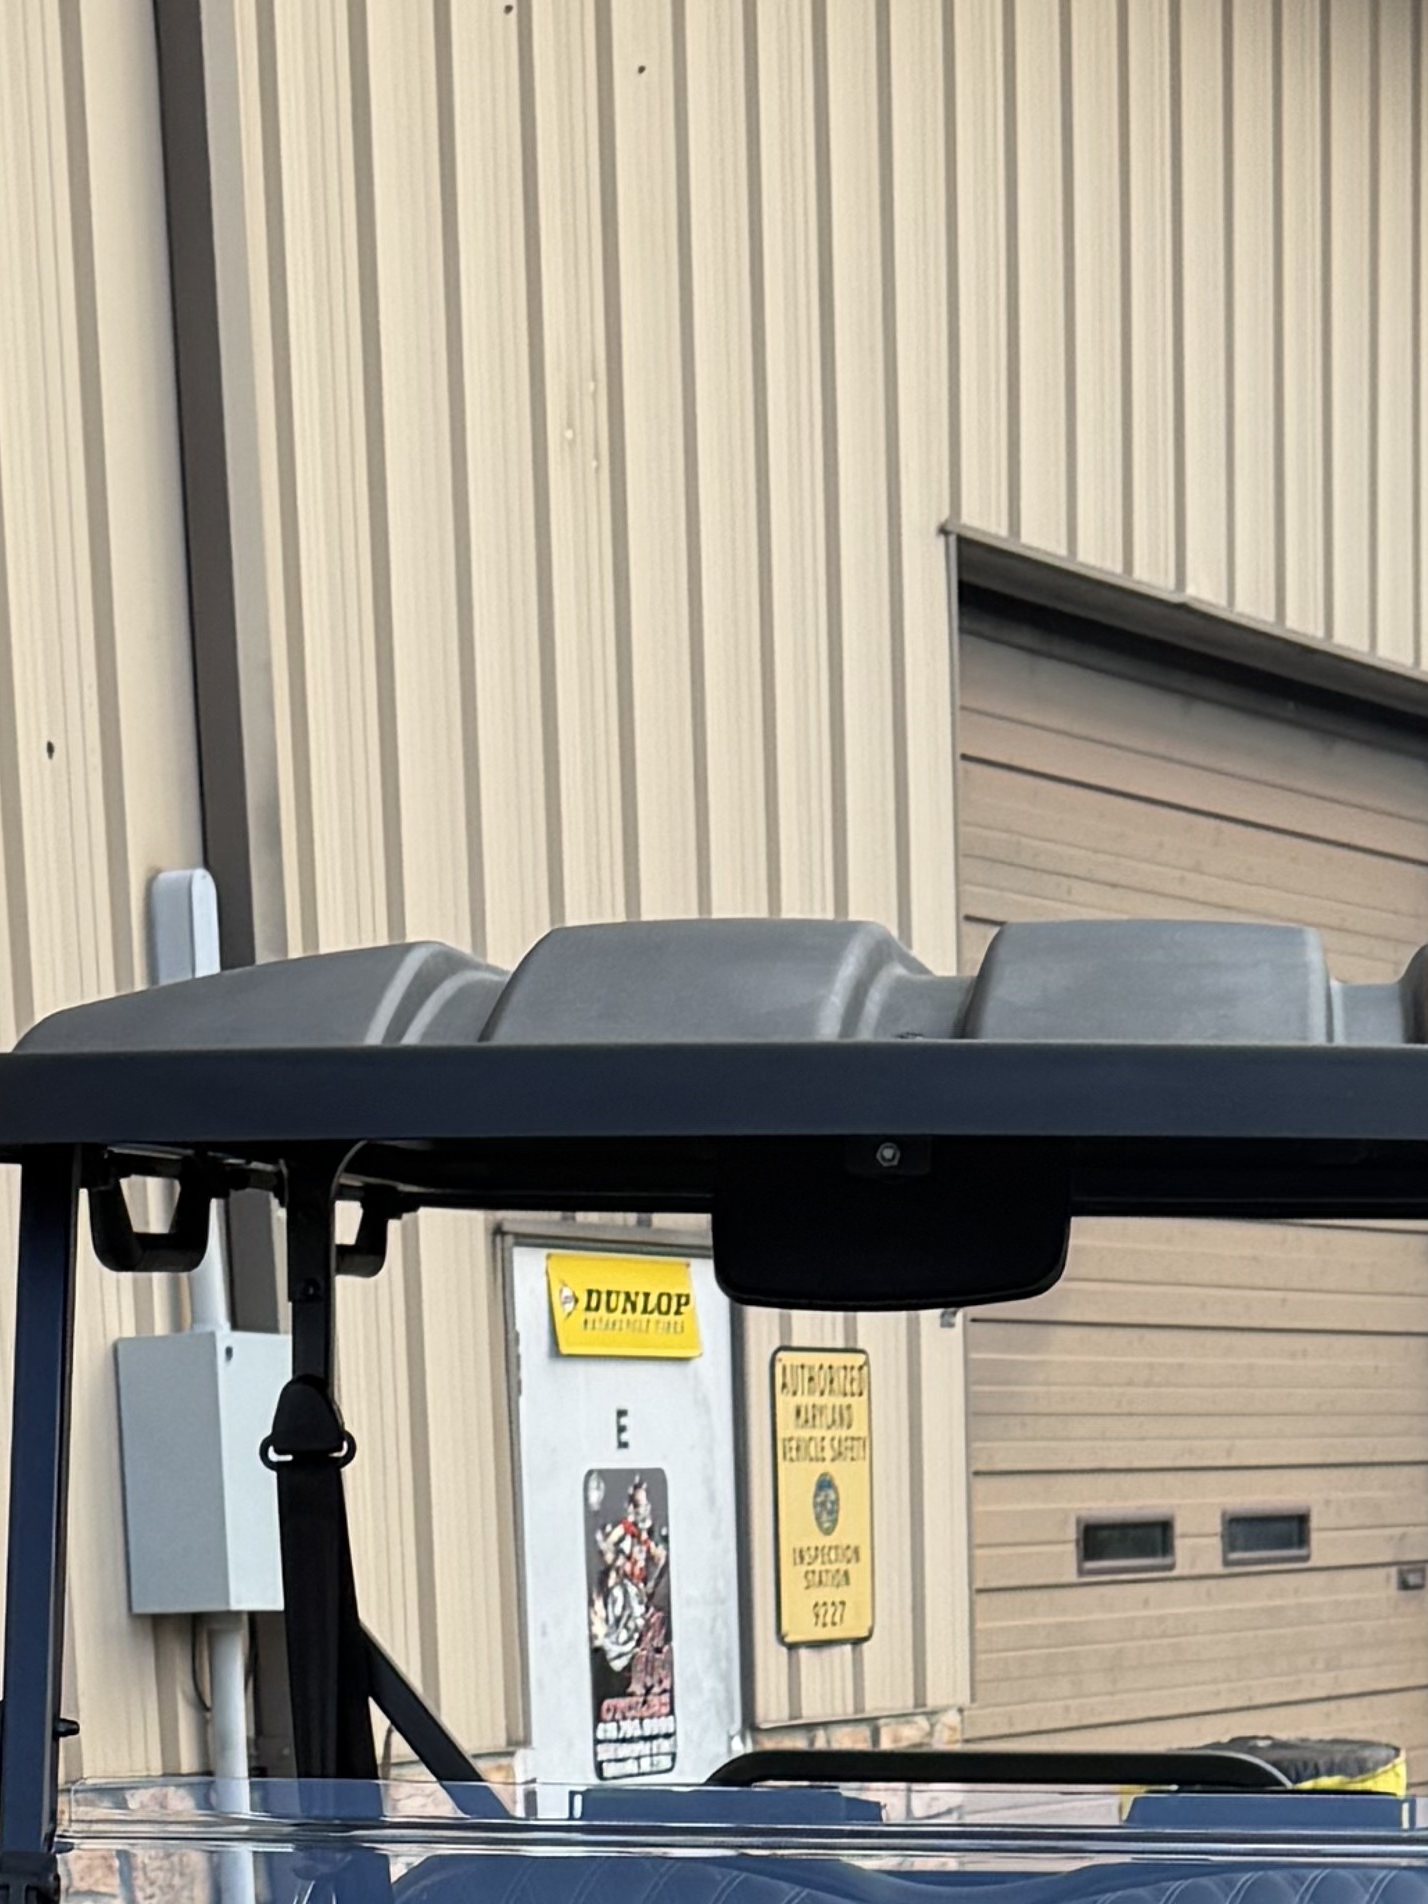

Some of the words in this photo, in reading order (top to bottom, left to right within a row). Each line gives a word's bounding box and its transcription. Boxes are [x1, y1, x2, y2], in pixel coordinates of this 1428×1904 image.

[584, 1288, 690, 1316] DUNLOP
[780, 1363, 866, 1397] AUTHORIZED
[616, 1408, 629, 1449] E
[794, 1403, 853, 1430] MARYLAND
[781, 1436, 826, 1462] VEHICLE
[830, 1436, 866, 1462] SAFETY
[792, 1544, 860, 1567] INSPECTION
[803, 1568, 850, 1590] STATION
[812, 1600, 847, 1628] 9227
